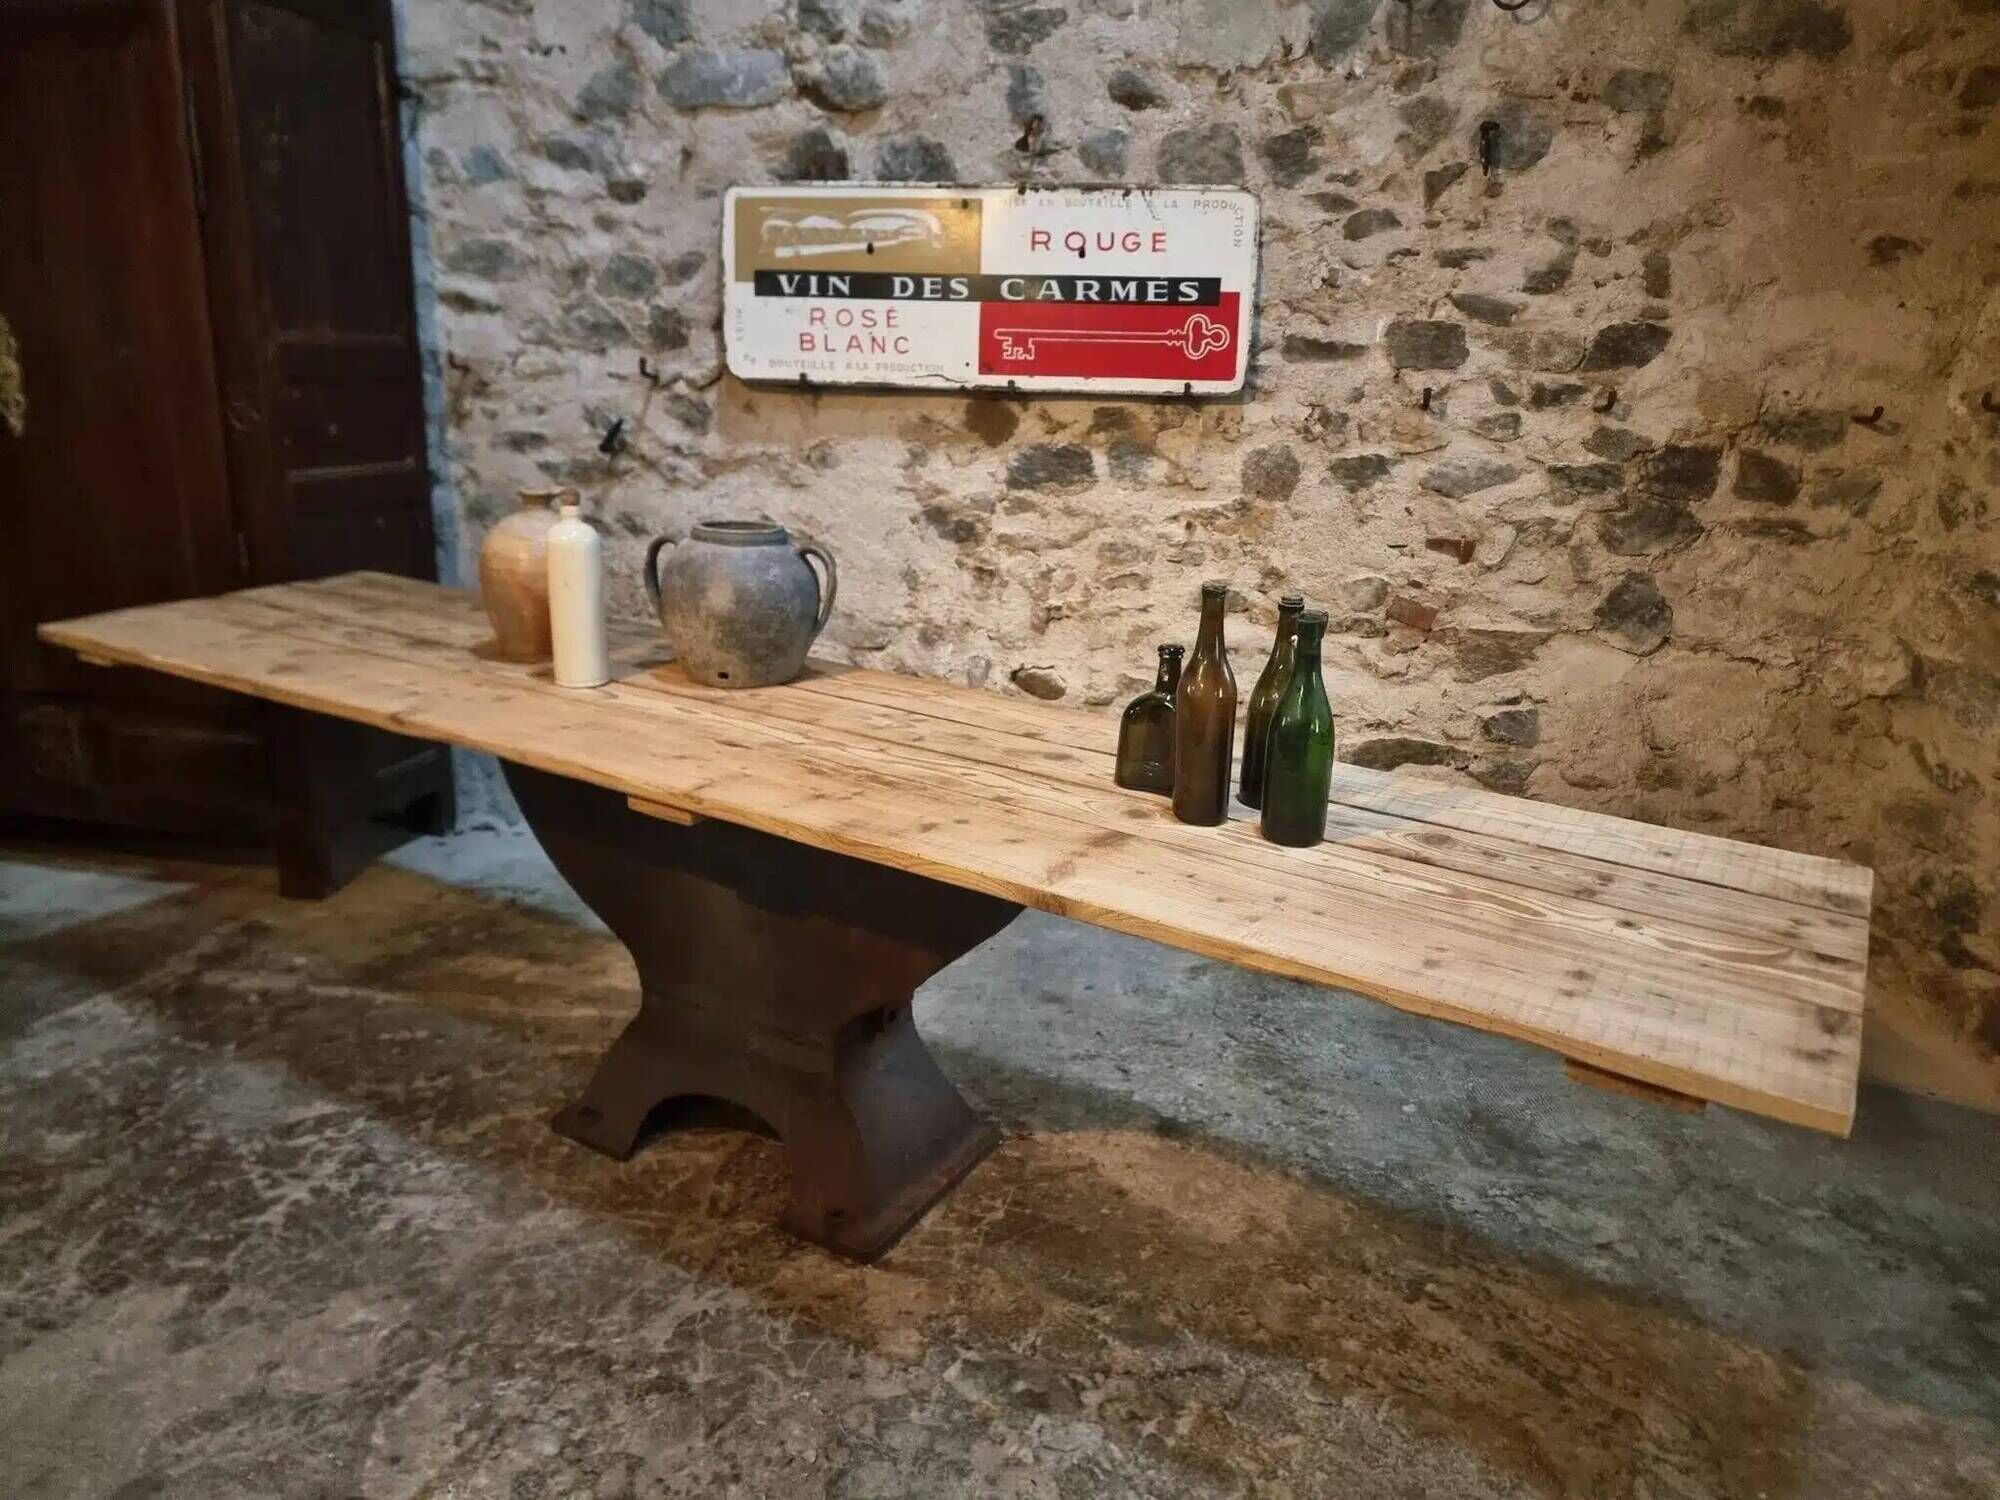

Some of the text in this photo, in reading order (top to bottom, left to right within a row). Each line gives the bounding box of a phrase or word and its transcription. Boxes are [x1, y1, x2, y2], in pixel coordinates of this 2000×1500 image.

[1064, 197, 1133, 209] BOUTEILLE
[1164, 199, 1178, 209] LA
[1193, 199, 1244, 248] PRODUCTION
[1030, 230, 1168, 253] ROUGE
[775, 273, 1201, 302] VIN DES CARMES
[809, 305, 900, 329] ROSÉ
[799, 332, 911, 355] BLANC
[768, 358, 836, 372] BOUTEILLE
[875, 362, 945, 373] PRODUCTION
